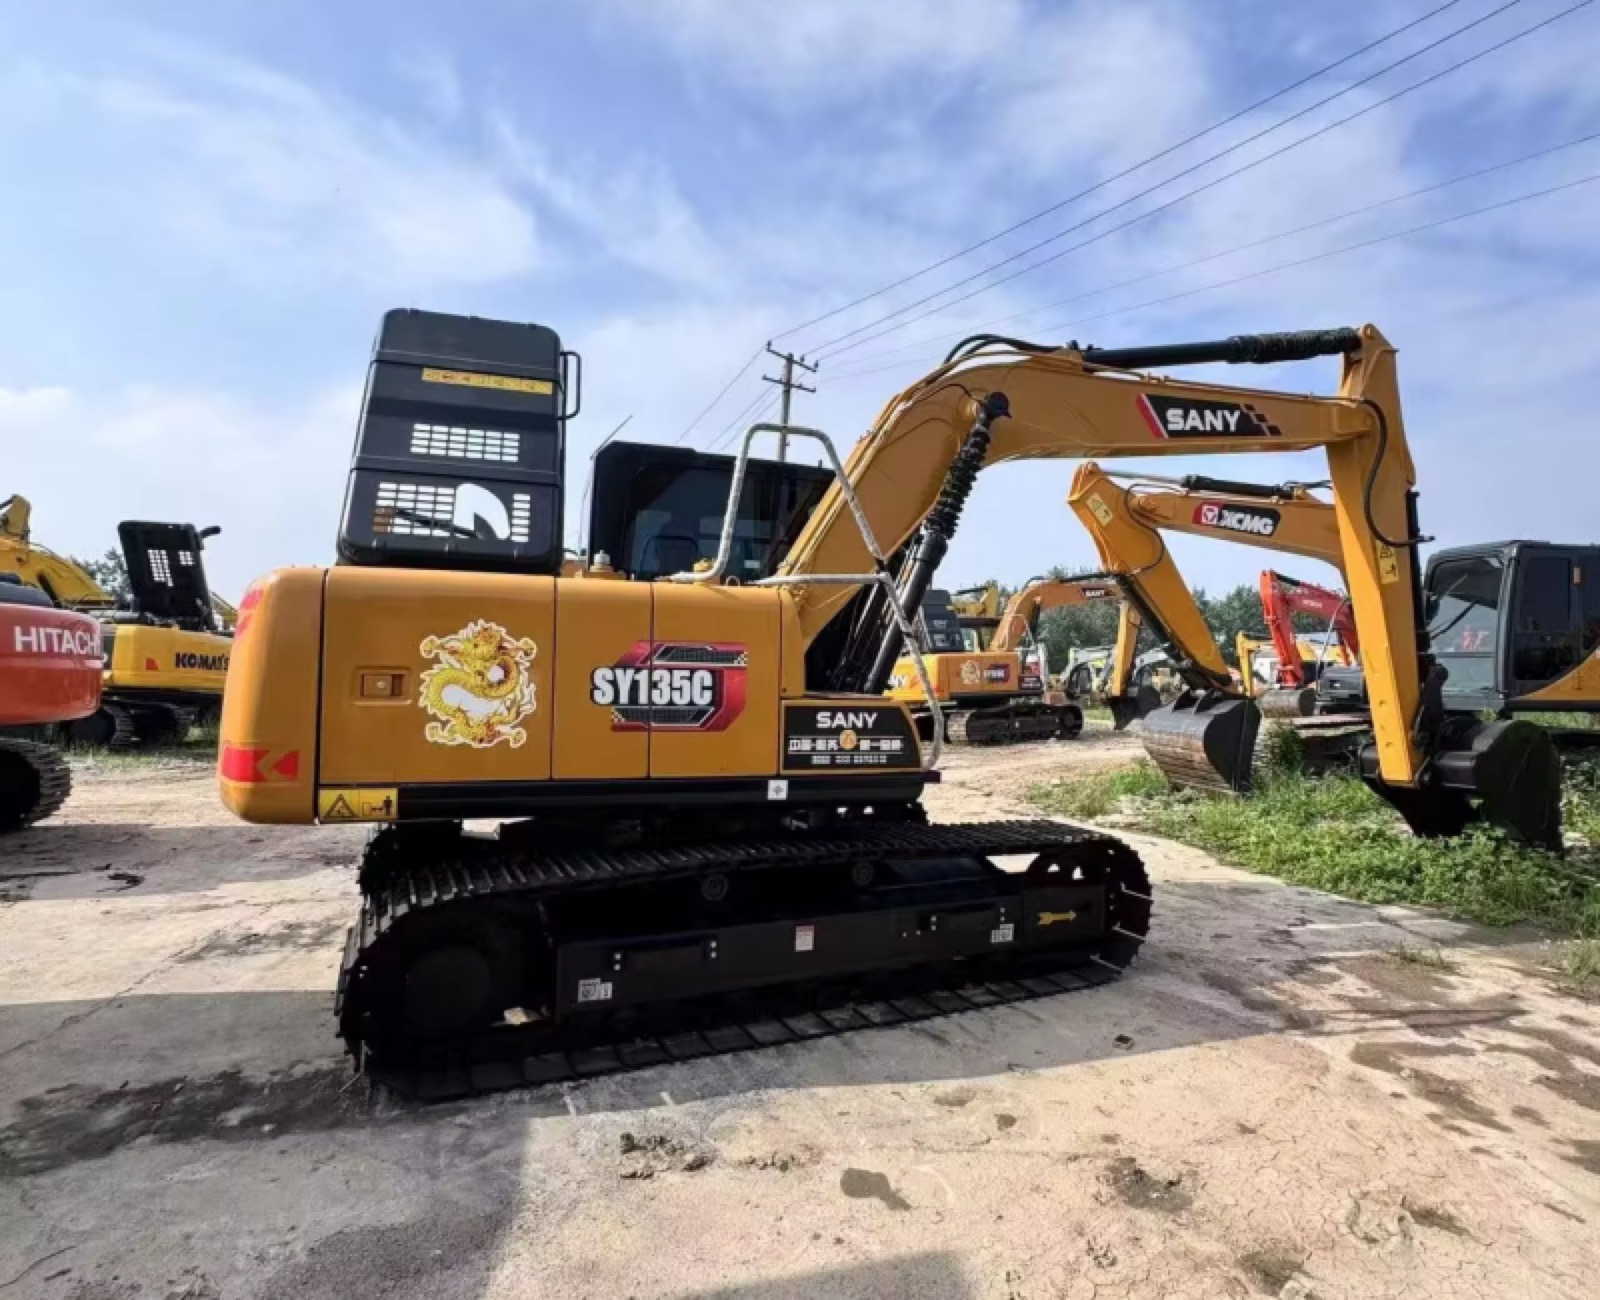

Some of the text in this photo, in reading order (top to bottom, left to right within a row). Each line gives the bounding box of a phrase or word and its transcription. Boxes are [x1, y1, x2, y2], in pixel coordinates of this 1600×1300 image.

[1166, 408, 1241, 432] SANY
[592, 667, 713, 705] SY135C
[816, 711, 878, 728] SANY
